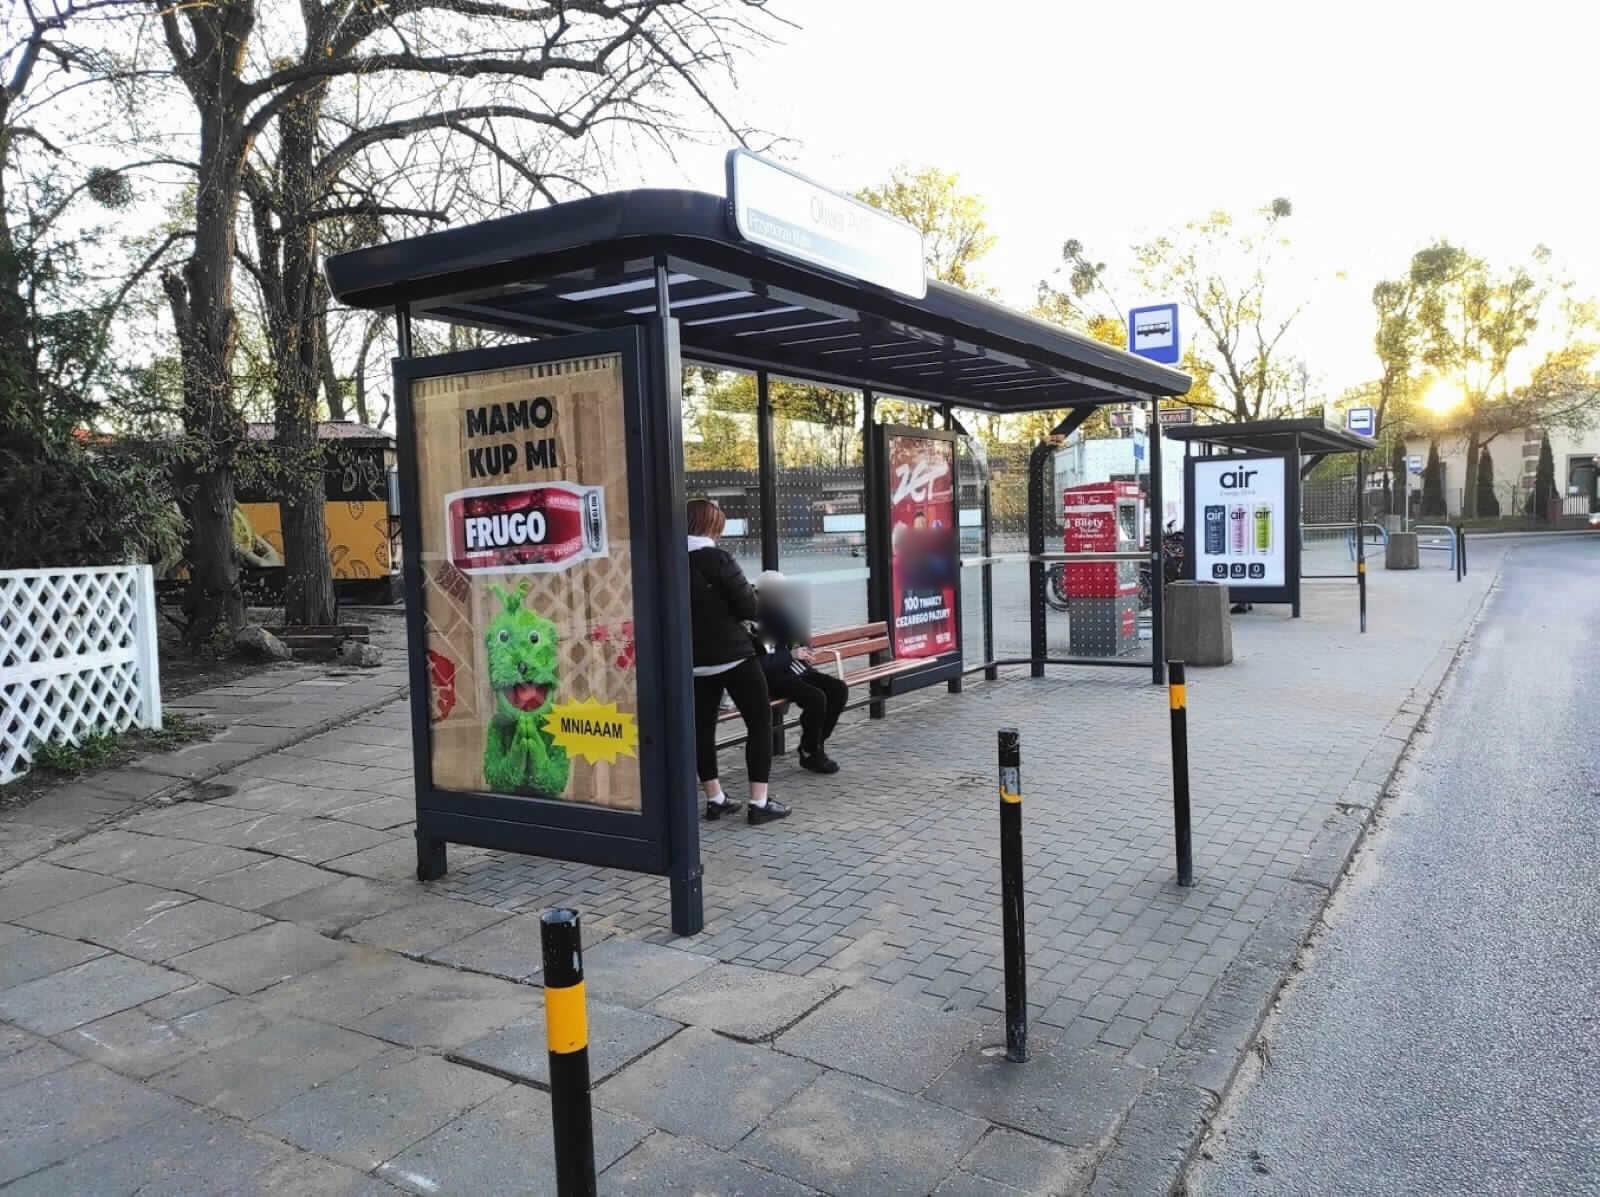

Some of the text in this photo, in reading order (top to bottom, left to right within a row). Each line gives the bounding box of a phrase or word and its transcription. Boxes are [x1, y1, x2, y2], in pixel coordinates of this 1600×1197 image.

[467, 396, 553, 438] MAMO
[469, 438, 558, 478] KUP MI
[1220, 465, 1258, 488] air
[1207, 510, 1224, 520] air
[1231, 508, 1247, 520] air
[1256, 508, 1272, 519] air
[465, 511, 546, 548] FRUGO
[1074, 518, 1104, 528] Bilety
[904, 597, 919, 612] 100
[560, 717, 623, 739] MNIAAAM
